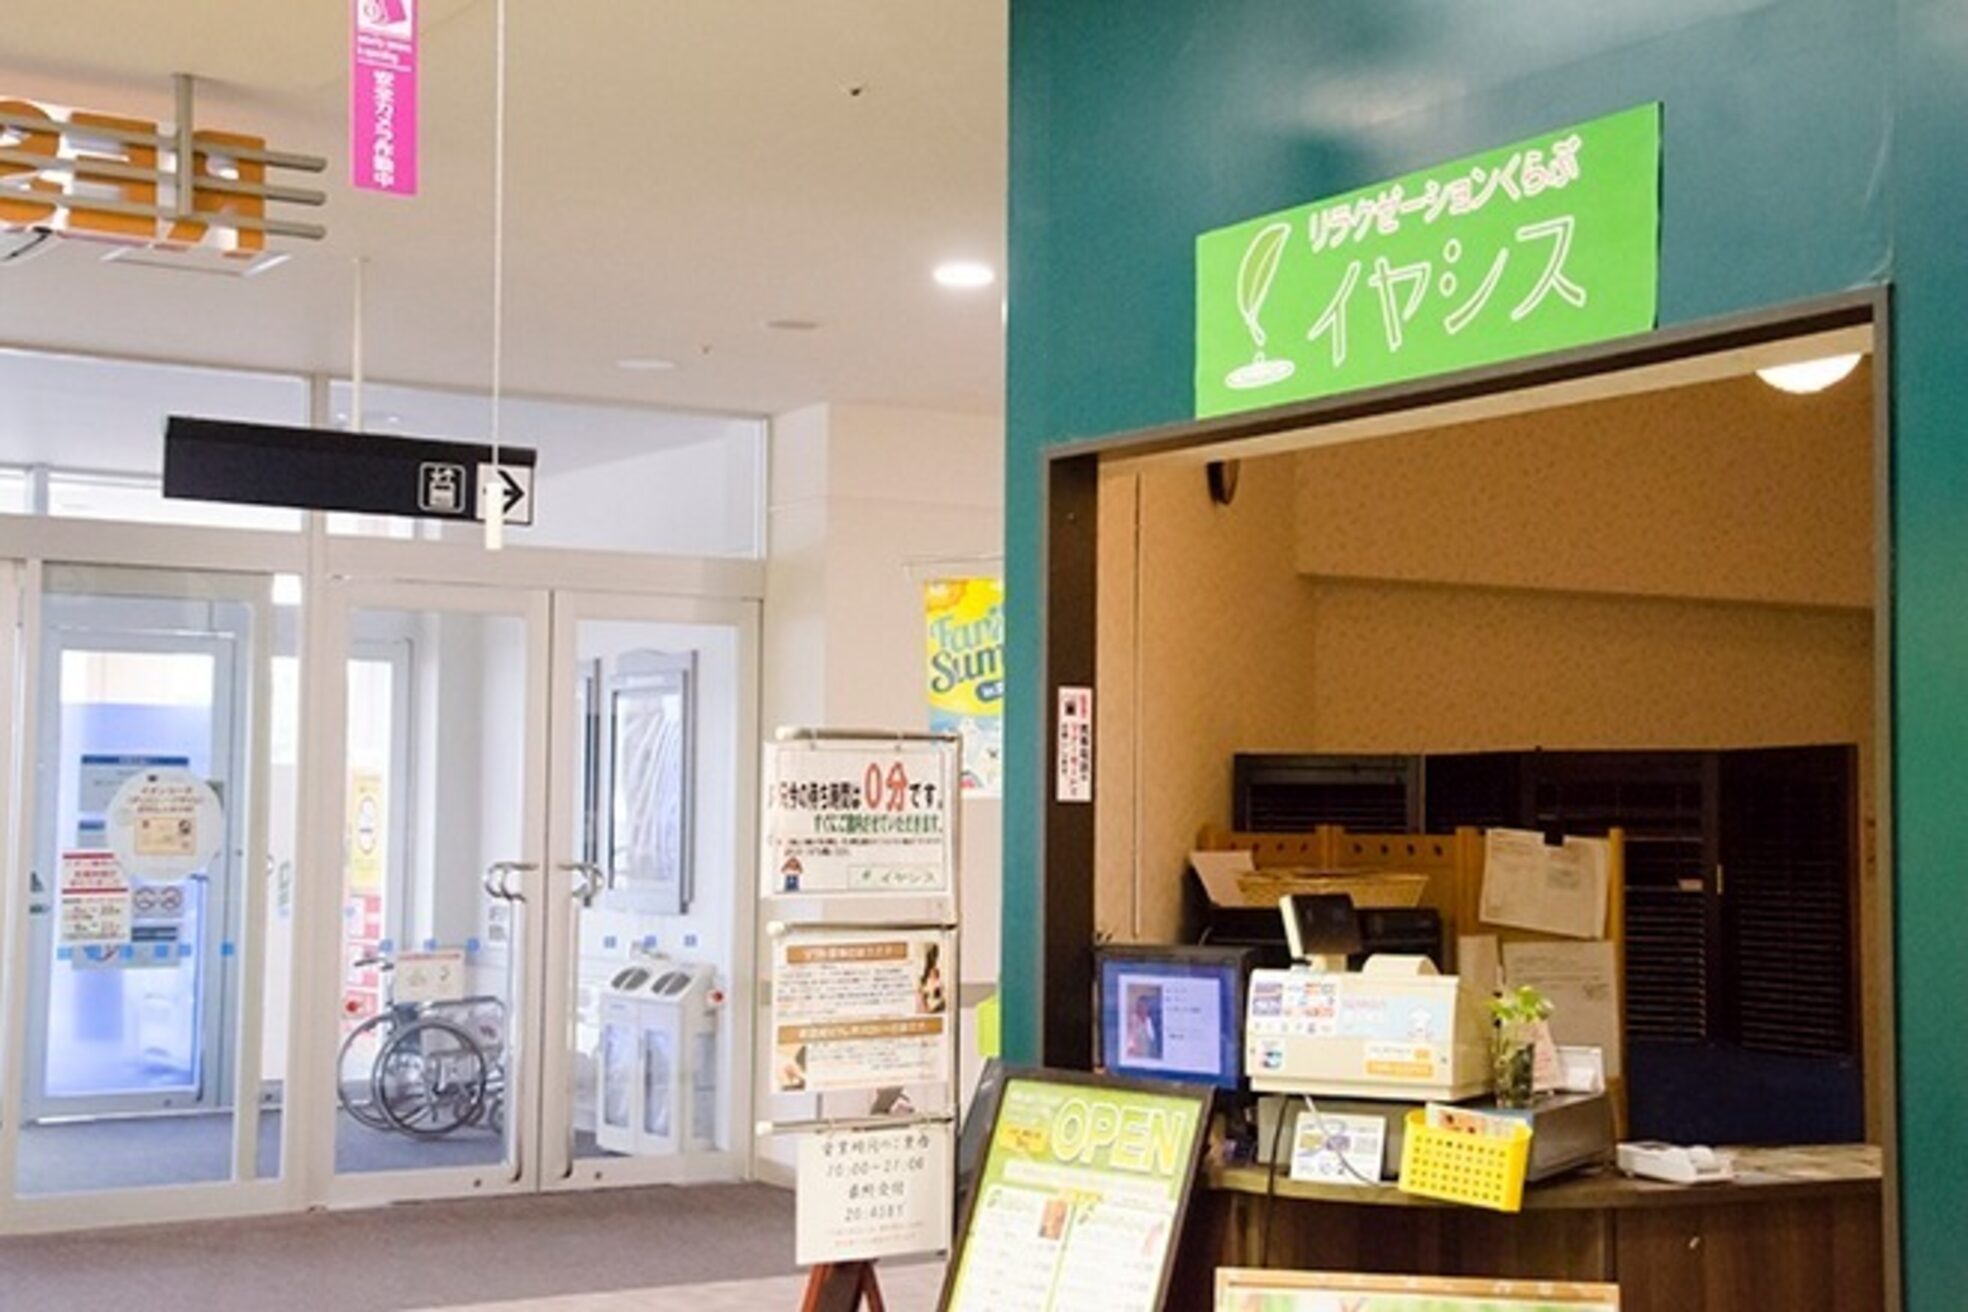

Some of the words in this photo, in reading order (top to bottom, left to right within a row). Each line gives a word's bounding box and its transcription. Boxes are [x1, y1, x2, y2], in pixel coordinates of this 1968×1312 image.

[1307, 134, 1583, 252] リラクゼーションくらぶ
[1308, 215, 1587, 368] イヤシス
[1051, 1097, 1187, 1174] OPEN
